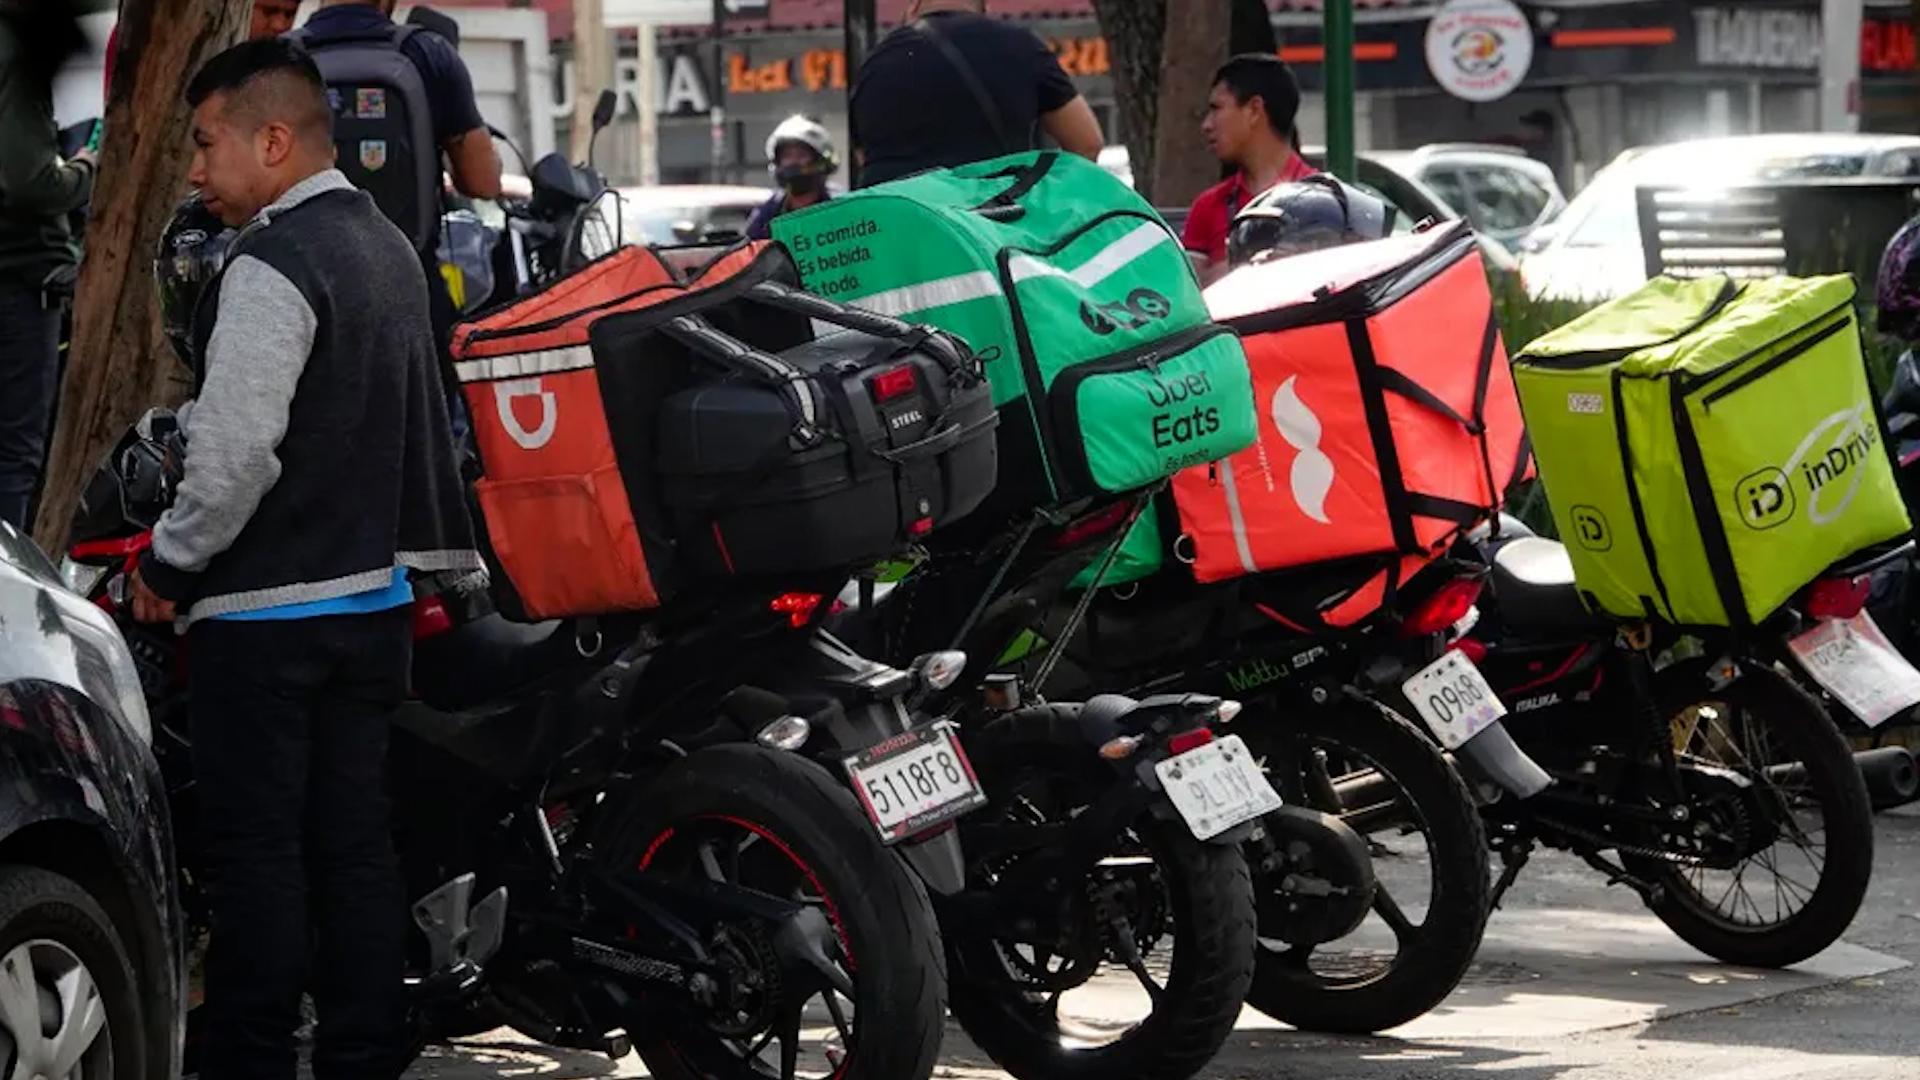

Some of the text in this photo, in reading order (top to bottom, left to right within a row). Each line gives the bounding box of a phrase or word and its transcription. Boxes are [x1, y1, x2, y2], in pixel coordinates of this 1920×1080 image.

[891, 410, 923, 430] STEEL
[1152, 405, 1221, 449] Eats
[1801, 422, 1877, 491] inDrive
[1225, 657, 1290, 694] Mottu
[1428, 673, 1484, 724] 0968
[866, 751, 959, 814] 5118F8
